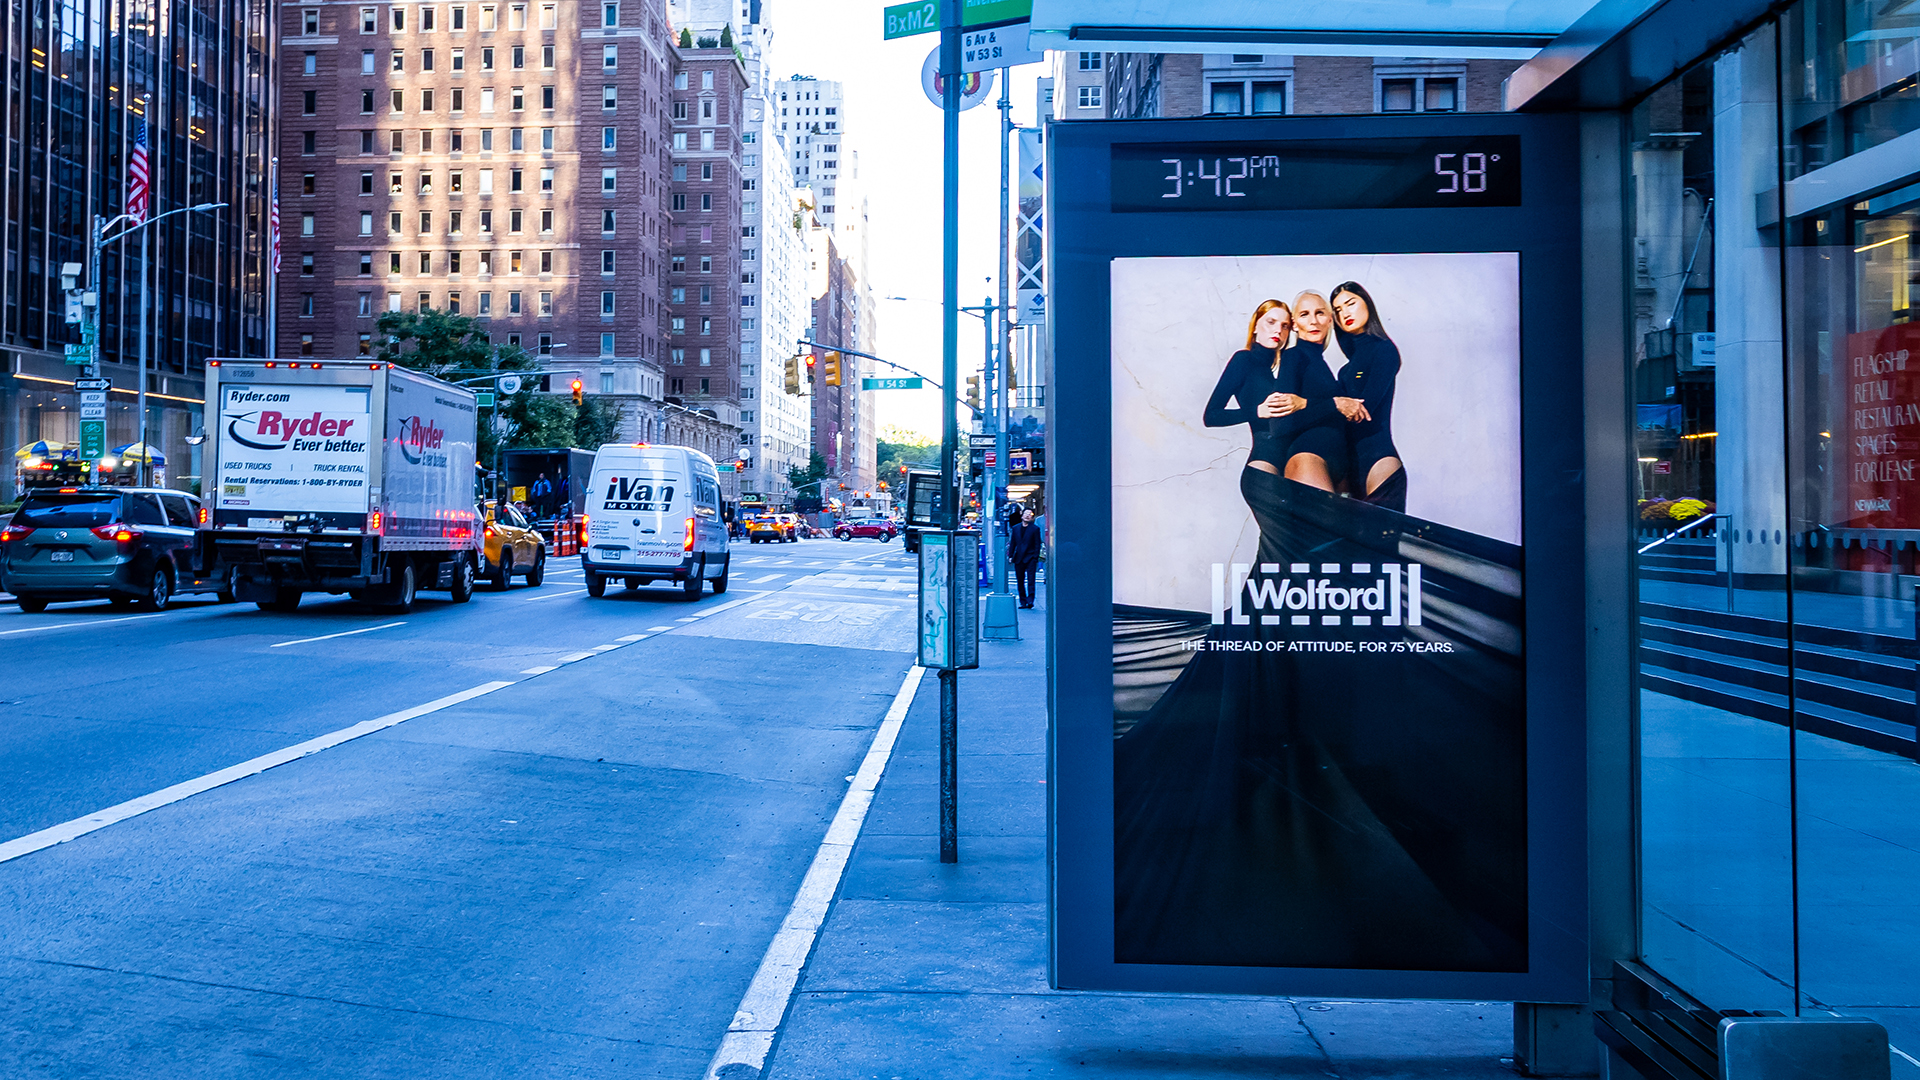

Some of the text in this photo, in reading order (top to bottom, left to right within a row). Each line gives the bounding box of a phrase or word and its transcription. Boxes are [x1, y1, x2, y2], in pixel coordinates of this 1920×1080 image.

[887, 3, 936, 34] BxM2
[965, 31, 997, 47] 6 Av &
[965, 46, 1003, 62] W 53 St
[1853, 349, 1910, 378] FLAGSHIP
[878, 379, 907, 388] W 54 St
[1854, 379, 1892, 404] RETAIL
[230, 391, 290, 403] Ryder.com
[257, 411, 354, 441] Ryder
[410, 415, 444, 454] Ryder
[292, 438, 366, 453] Ever better.
[1855, 433, 1897, 457] SPACES
[224, 461, 365, 473] USED TRUCKS TRUCK RENTAL
[1855, 458, 1915, 483] FOR LEASE
[224, 476, 364, 488] Rental Reservations: 1-800-BY-RYDER
[605, 476, 678, 503] iVan
[606, 502, 668, 511] MOVING
[1854, 499, 1892, 512] NEWMARK
[636, 550, 681, 558] 315-277-7795
[1247, 578, 1386, 611] Wolford
[744, 608, 880, 626] BUS
[1179, 640, 1455, 654] THE THREAD OF ATTITUDE, FOR 75 YEARS.
